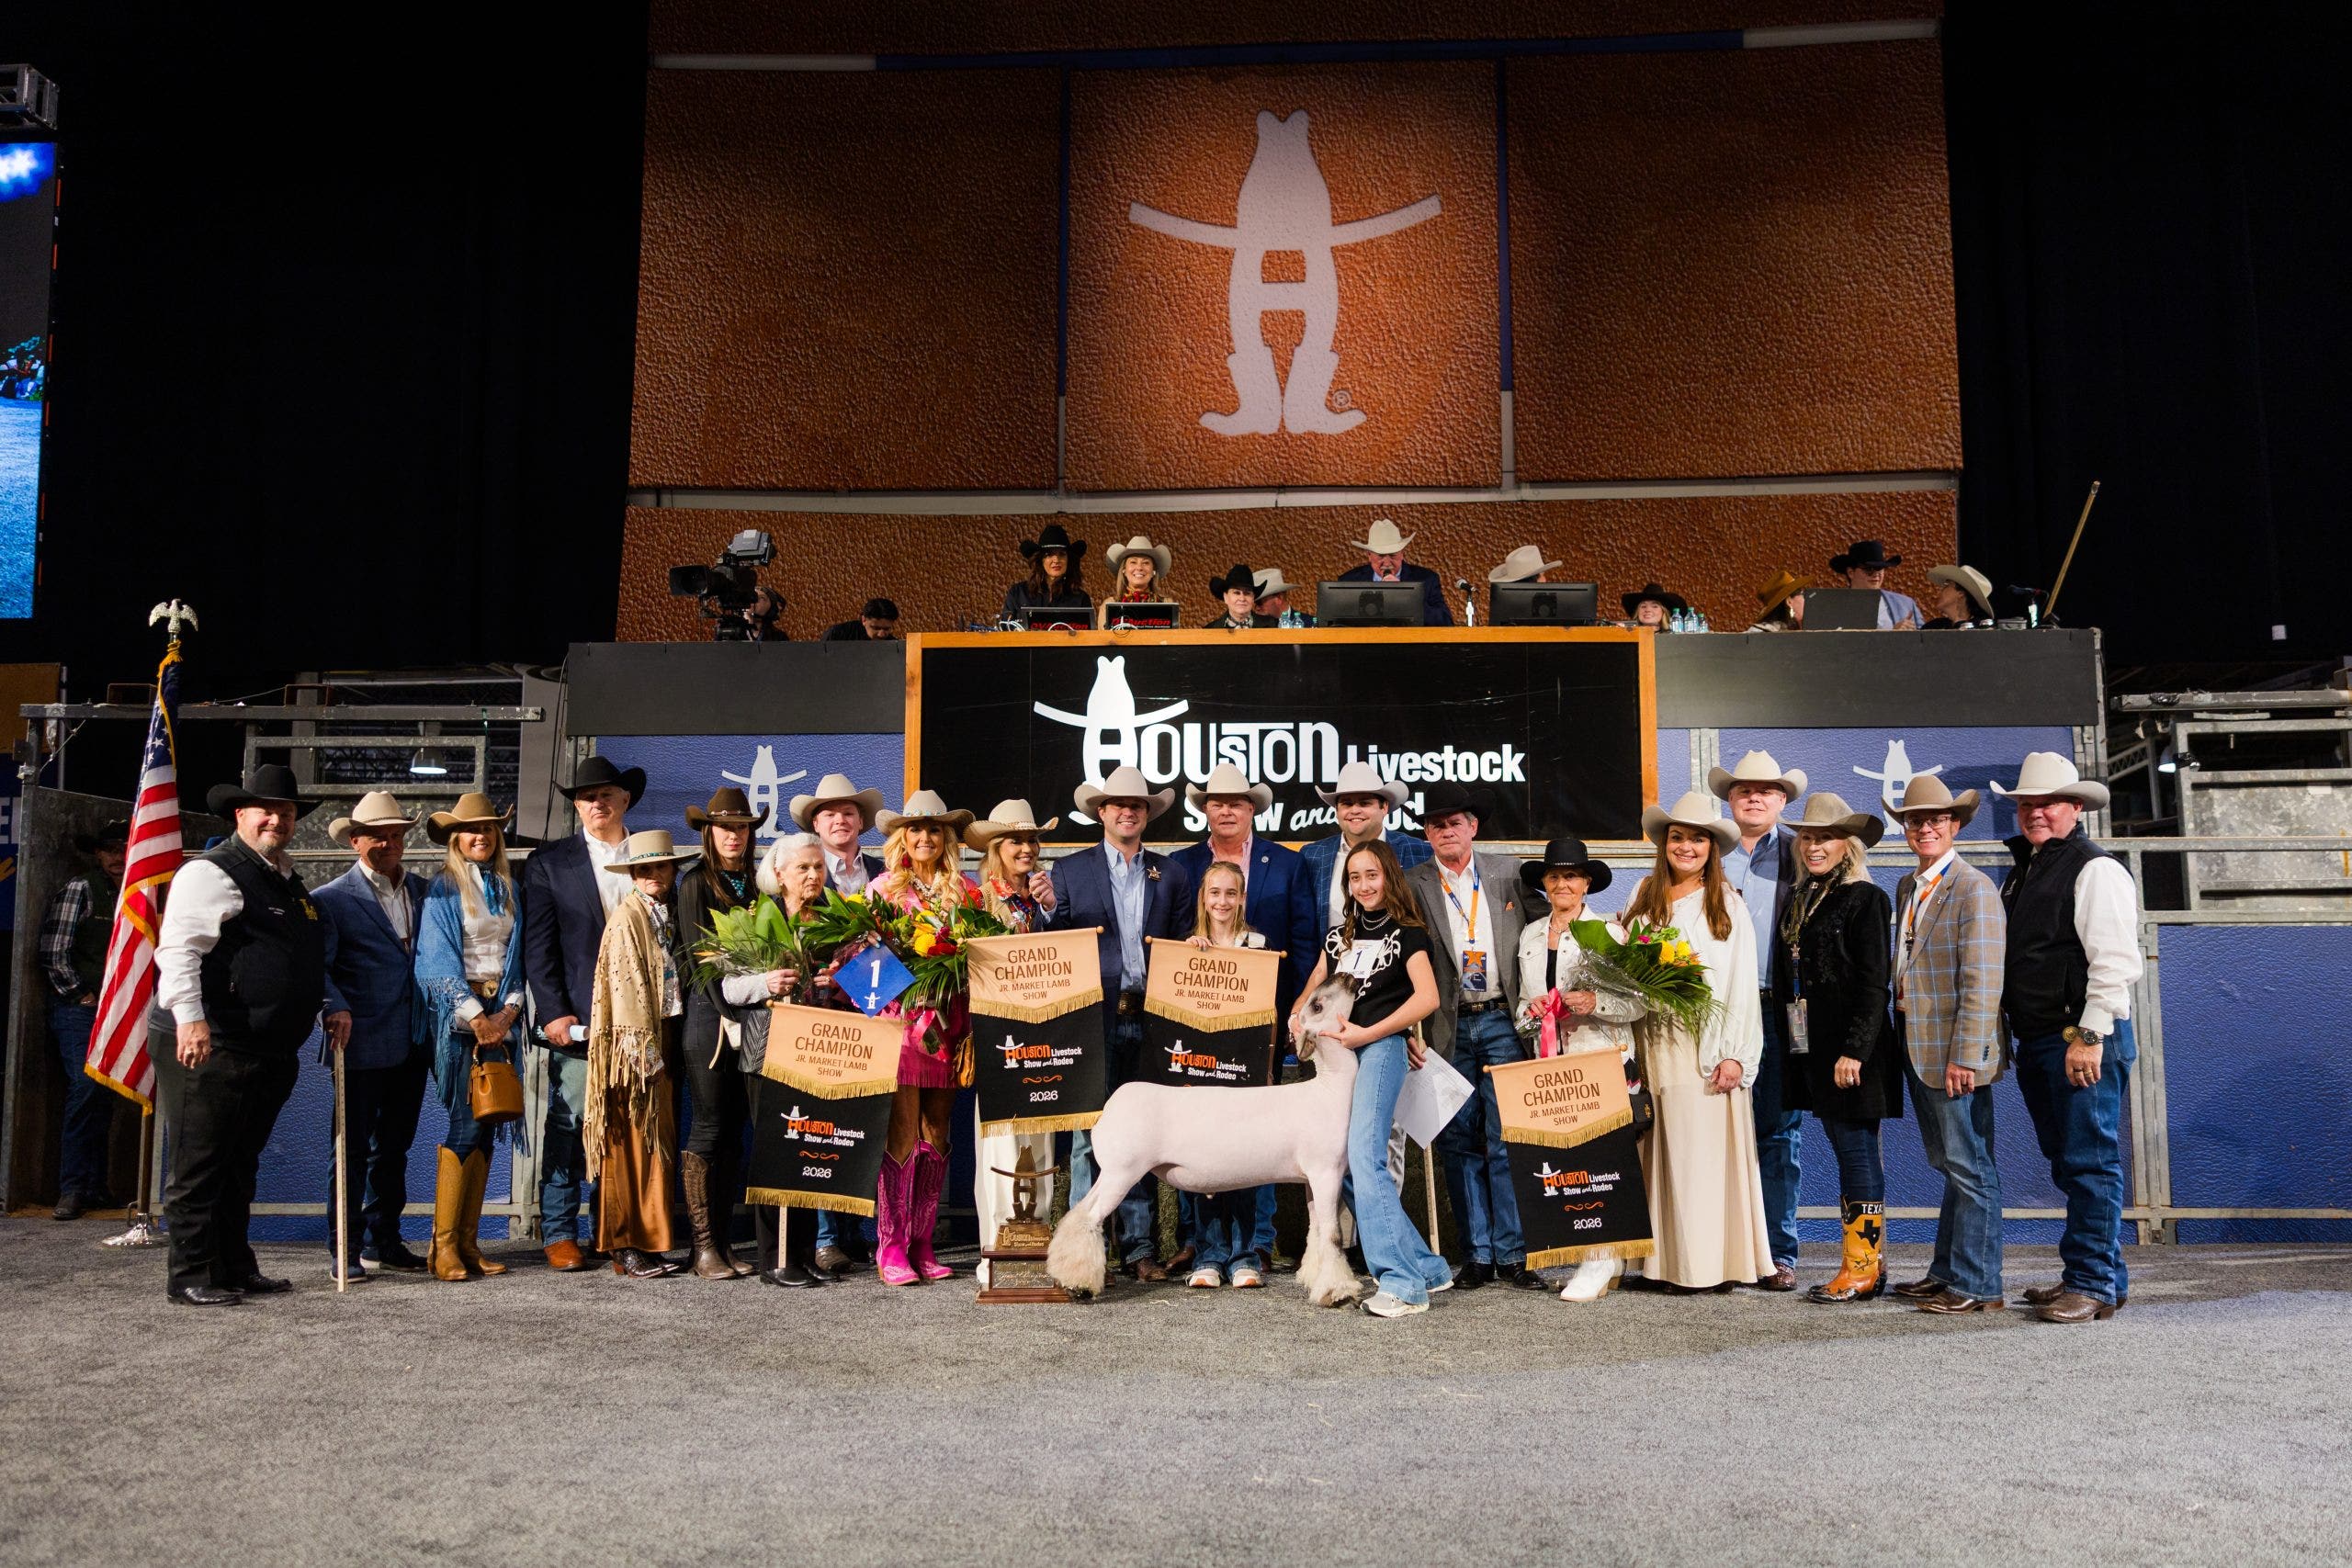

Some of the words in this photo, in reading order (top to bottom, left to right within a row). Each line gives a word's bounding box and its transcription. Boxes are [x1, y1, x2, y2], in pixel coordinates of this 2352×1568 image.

[1183, 796, 1283, 832] Sw
[1008, 946, 1057, 963] GRAND
[1353, 950, 1363, 969] 1
[995, 962, 1072, 981] CHAMPION
[1189, 957, 1237, 975] GRAND
[871, 960, 880, 987] 1
[1012, 981, 1045, 991] MARKET
[1046, 979, 1070, 988] LAMB
[1174, 972, 1249, 992] CHAMPION
[1023, 991, 1047, 1000] SHOW
[1175, 988, 1185, 997] JR.
[1188, 990, 1219, 1000] MARKET
[1222, 995, 1245, 1003] LAMB
[1196, 1001, 1221, 1010] SHOW
[812, 1023, 862, 1042] GRAND
[796, 1037, 873, 1059] CHAMPION
[1051, 1047, 1082, 1056] Livestock
[796, 1055, 806, 1063] JR.
[809, 1056, 842, 1067] MARKET
[844, 1060, 867, 1070] LAMB
[1023, 1060, 1041, 1068] Show
[1053, 1057, 1073, 1066] Rodeo
[1216, 1061, 1247, 1072] Livestock
[818, 1067, 842, 1077] SHOW
[1188, 1067, 1205, 1077] Show
[1216, 1071, 1236, 1080] Rodeo
[1534, 1068, 1583, 1088] GRAND
[1030, 1090, 1058, 1102] 2026
[1523, 1083, 1600, 1107] CHAMPION
[1530, 1110, 1541, 1119] JR.
[1542, 1105, 1575, 1117] MARKET
[1577, 1101, 1600, 1111] LAMB
[1553, 1115, 1578, 1126] SHOW
[833, 1128, 865, 1139] Livestock
[805, 1134, 822, 1143] Show
[833, 1137, 854, 1146] Rodeo
[803, 1167, 832, 1179] 2026
[1589, 1172, 1620, 1183] Livestock
[1564, 1187, 1580, 1195] Show
[1592, 1183, 1612, 1192] Rodeo
[1861, 1203, 1883, 1214] TEXA
[1574, 1218, 1602, 1230] 2026
